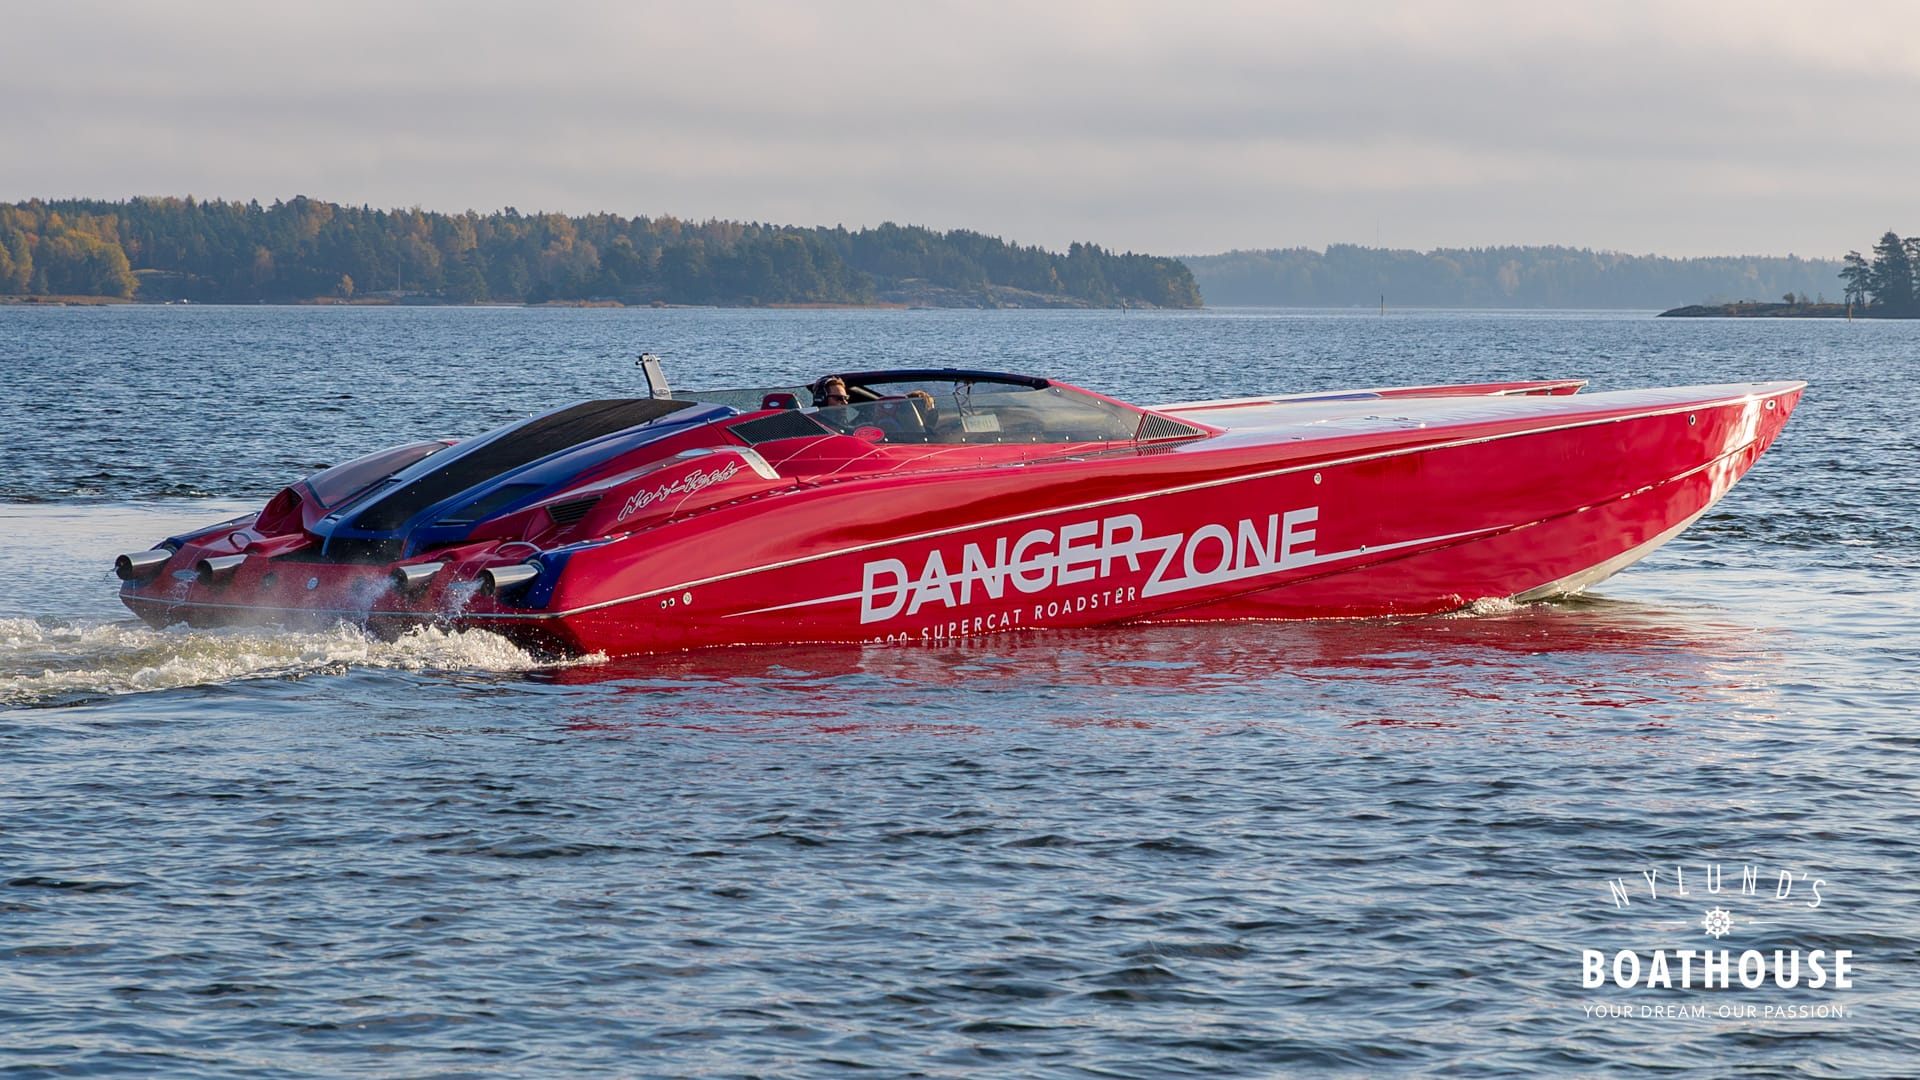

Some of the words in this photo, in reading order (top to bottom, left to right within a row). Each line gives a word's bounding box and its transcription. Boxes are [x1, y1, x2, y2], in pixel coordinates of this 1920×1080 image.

[860, 513, 1143, 624] DANGER
[1141, 506, 1319, 598] ZONE
[921, 609, 1022, 640] SUPERCAT
[1034, 586, 1136, 621] ROADSTER
